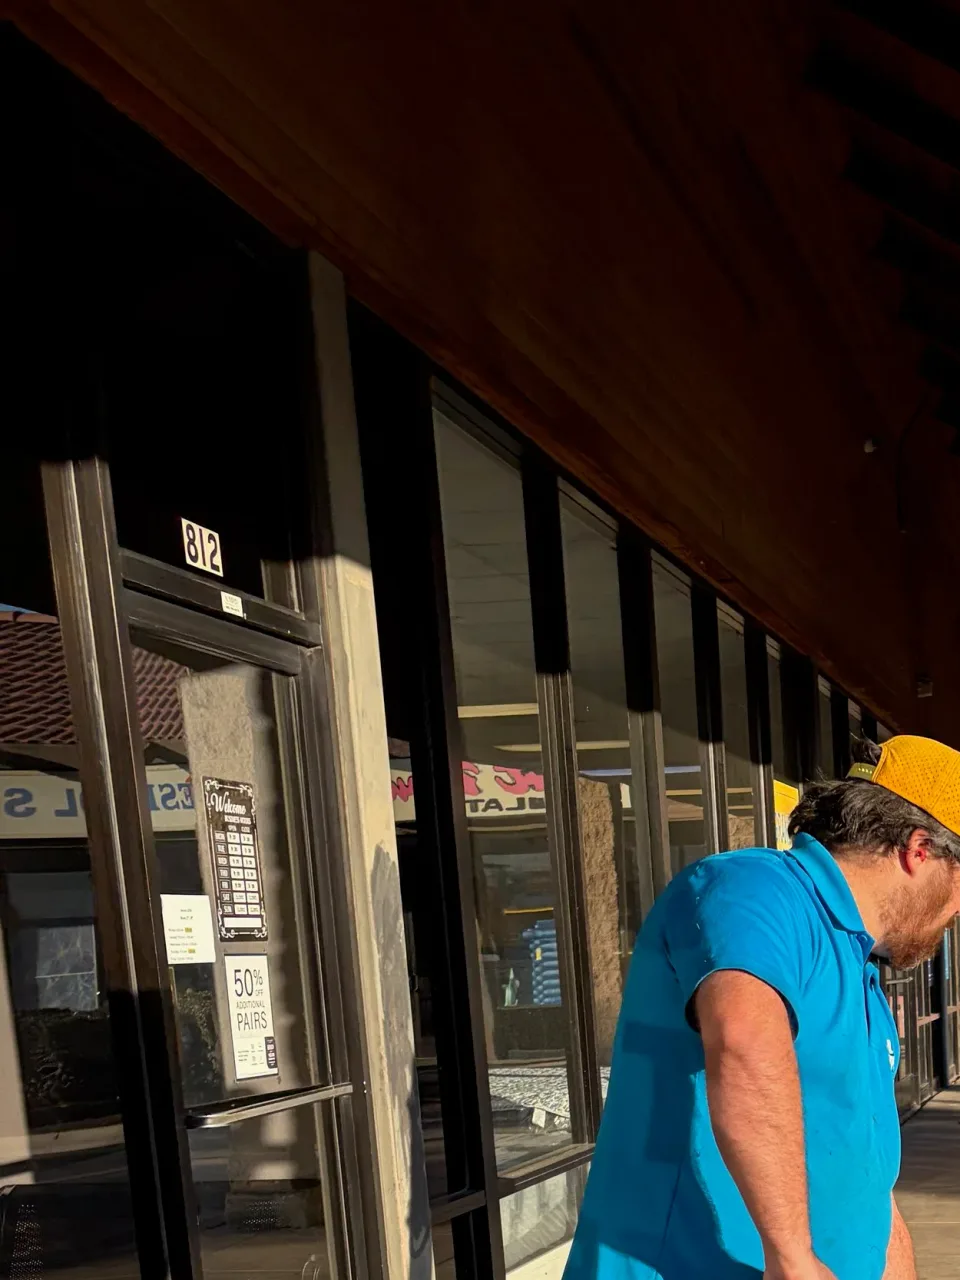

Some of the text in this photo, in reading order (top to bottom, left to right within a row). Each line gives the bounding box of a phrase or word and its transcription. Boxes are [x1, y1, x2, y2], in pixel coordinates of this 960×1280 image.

[185, 523, 220, 573] 812
[210, 791, 247, 815] Welcome
[233, 968, 264, 997] 50% OFF
[236, 999, 266, 1010] ADDITIONAL
[236, 1011, 268, 1032] PAIRS
